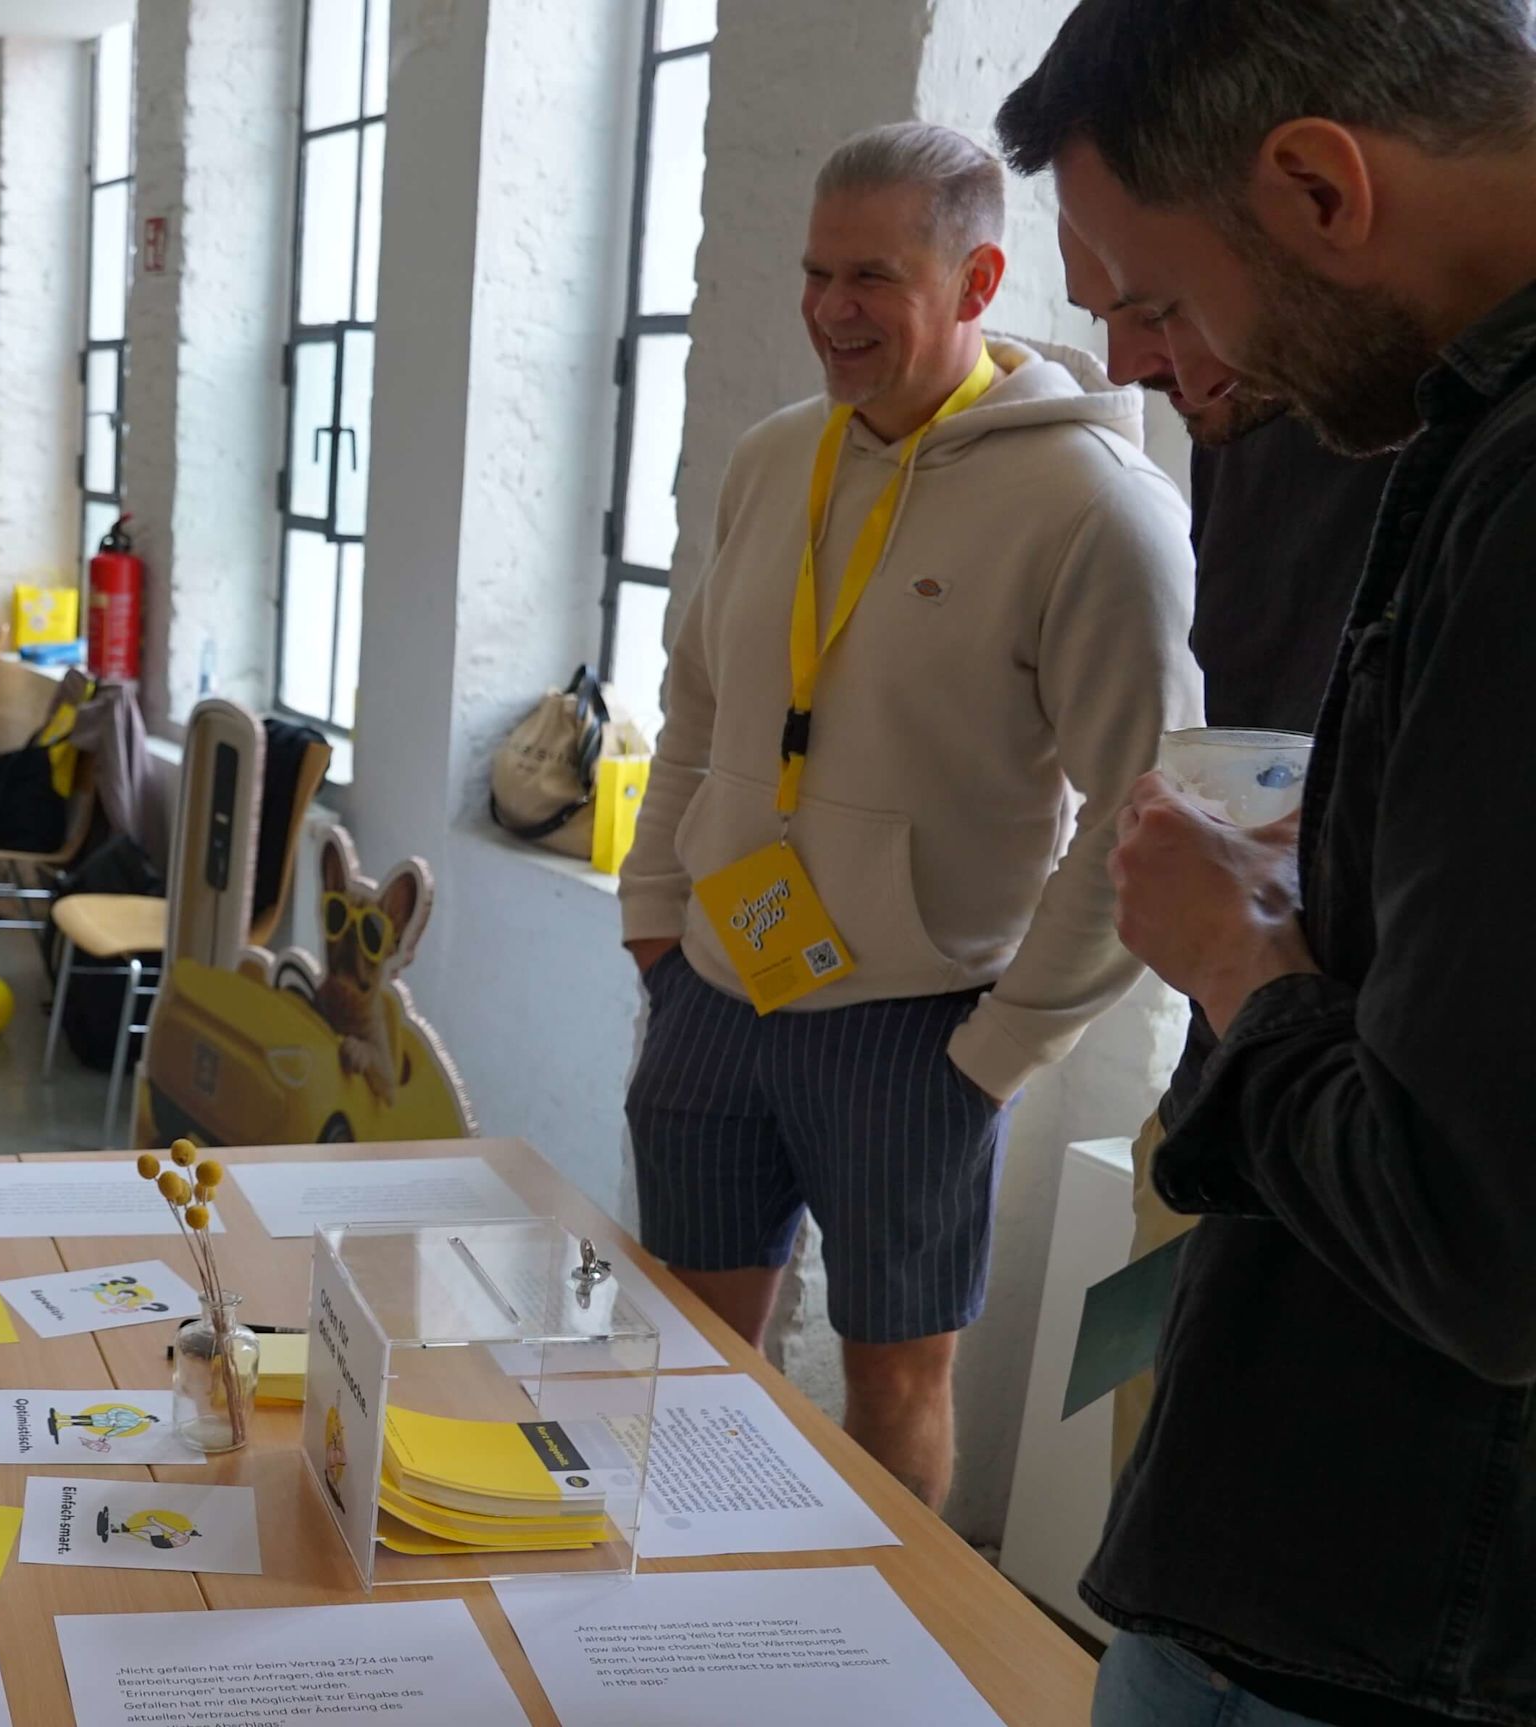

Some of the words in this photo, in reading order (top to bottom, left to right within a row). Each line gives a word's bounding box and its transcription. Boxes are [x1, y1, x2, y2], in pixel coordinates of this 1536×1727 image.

[320, 1288, 338, 1333] Offen
[336, 1344, 369, 1419] Wünsche.
[13, 1397, 34, 1454] Optimistisch.
[60, 1486, 77, 1523] Einfach
[58, 1522, 74, 1555] smart.
[584, 1634, 628, 1643] already
[630, 1633, 653, 1641] was
[654, 1632, 688, 1642] using
[687, 1631, 716, 1640] Yello
[717, 1630, 734, 1638] for
[737, 1628, 779, 1638] normal
[779, 1627, 818, 1636] Strom
[819, 1626, 843, 1635] and
[600, 1623, 658, 1632] extremely
[660, 1621, 710, 1630] satisfied
[711, 1620, 734, 1628] and
[584, 1646, 609, 1654] now
[611, 1645, 635, 1653] also
[637, 1644, 666, 1652] have
[668, 1643, 711, 1652] chosen
[711, 1641, 741, 1650] Yello
[741, 1640, 759, 1648] for
[760, 1637, 846, 1648] Wärmepumpe
[157, 1665, 207, 1675] gefallen
[209, 1664, 229, 1672] hat
[232, 1663, 253, 1671] mir
[255, 1661, 287, 1670] beim
[289, 1659, 336, 1669] Vertrag
[337, 1656, 376, 1666] 23/24
[378, 1655, 398, 1664] die
[400, 1654, 434, 1664] lange
[589, 1656, 631, 1665] Strom.
[638, 1655, 676, 1663] would
[677, 1653, 706, 1662] have
[707, 1653, 736, 1661] liked
[737, 1651, 755, 1660] for
[756, 1650, 791, 1659] there
[792, 1649, 806, 1657] to
[806, 1648, 836, 1657] have
[836, 1647, 869, 1656] been
[117, 1675, 224, 1687] Bearbeitungszeit
[227, 1674, 250, 1682] von
[253, 1671, 315, 1682] Anfragen,
[315, 1670, 334, 1679] die
[336, 1669, 362, 1678] erst
[364, 1667, 394, 1676] nach
[596, 1669, 612, 1677] an
[613, 1667, 654, 1676] option
[655, 1666, 670, 1674] to
[671, 1665, 695, 1673] add
[707, 1663, 758, 1672] contract
[759, 1662, 774, 1670] to
[776, 1662, 791, 1670] an
[792, 1660, 840, 1669] existing
[841, 1658, 891, 1667] account
[218, 1684, 298, 1695] beantwortet
[300, 1681, 351, 1691] wurden.
[601, 1679, 615, 1687] in
[615, 1678, 638, 1687] the
[123, 1700, 178, 1711] Gefallen
[180, 1700, 201, 1709] hat
[203, 1698, 224, 1707] mir
[227, 1697, 248, 1706] die
[250, 1694, 323, 1705] Möglichkeit
[326, 1693, 345, 1702] zur
[347, 1690, 399, 1701] Eingabe
[401, 1689, 424, 1698] des
[127, 1713, 187, 1723] aktuellen
[187, 1709, 261, 1720] Verbrauchs
[263, 1707, 288, 1717] und
[290, 1706, 311, 1716] der
[315, 1703, 378, 1714] Änderung
[379, 1701, 403, 1711] des
